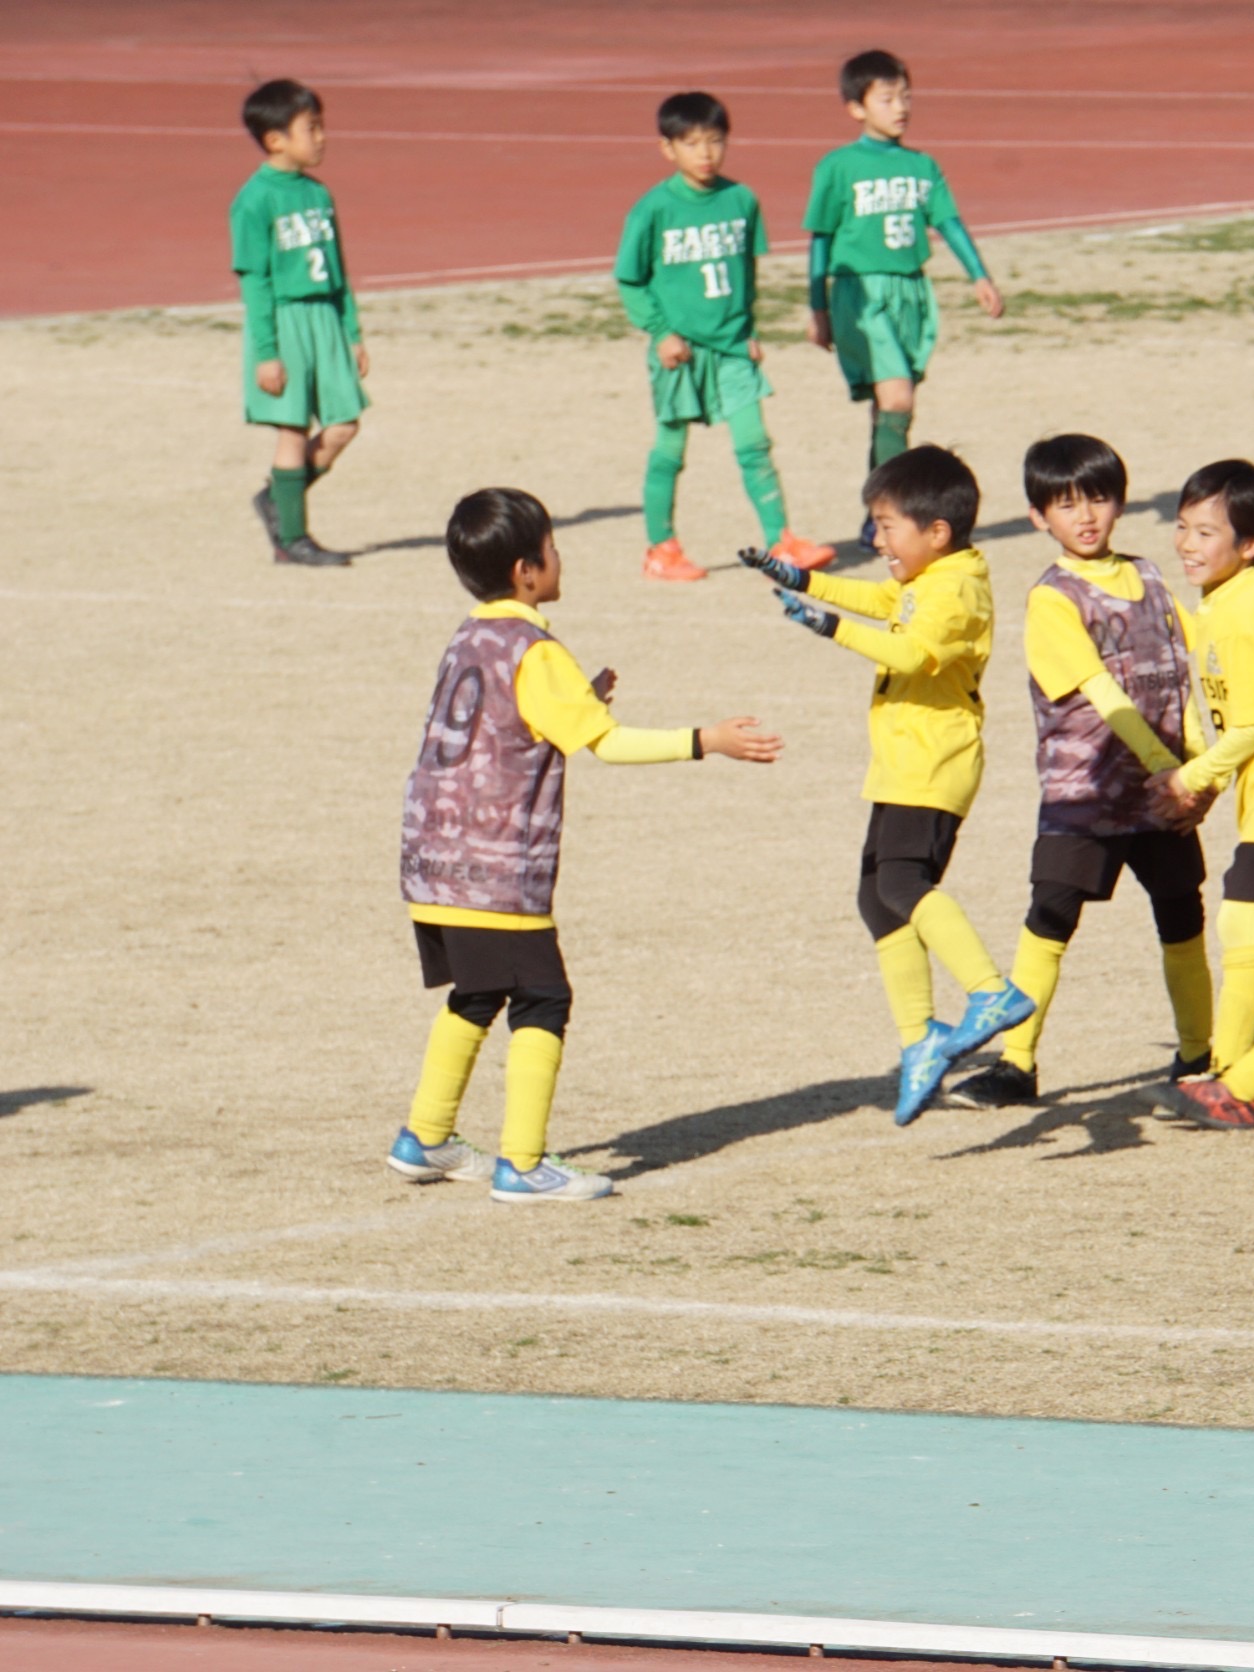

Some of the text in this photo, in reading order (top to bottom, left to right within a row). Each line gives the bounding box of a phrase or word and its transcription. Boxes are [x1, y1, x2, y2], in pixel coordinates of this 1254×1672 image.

[883, 212, 916, 250] 55
[307, 246, 329, 281] 2
[700, 261, 733, 298] 11
